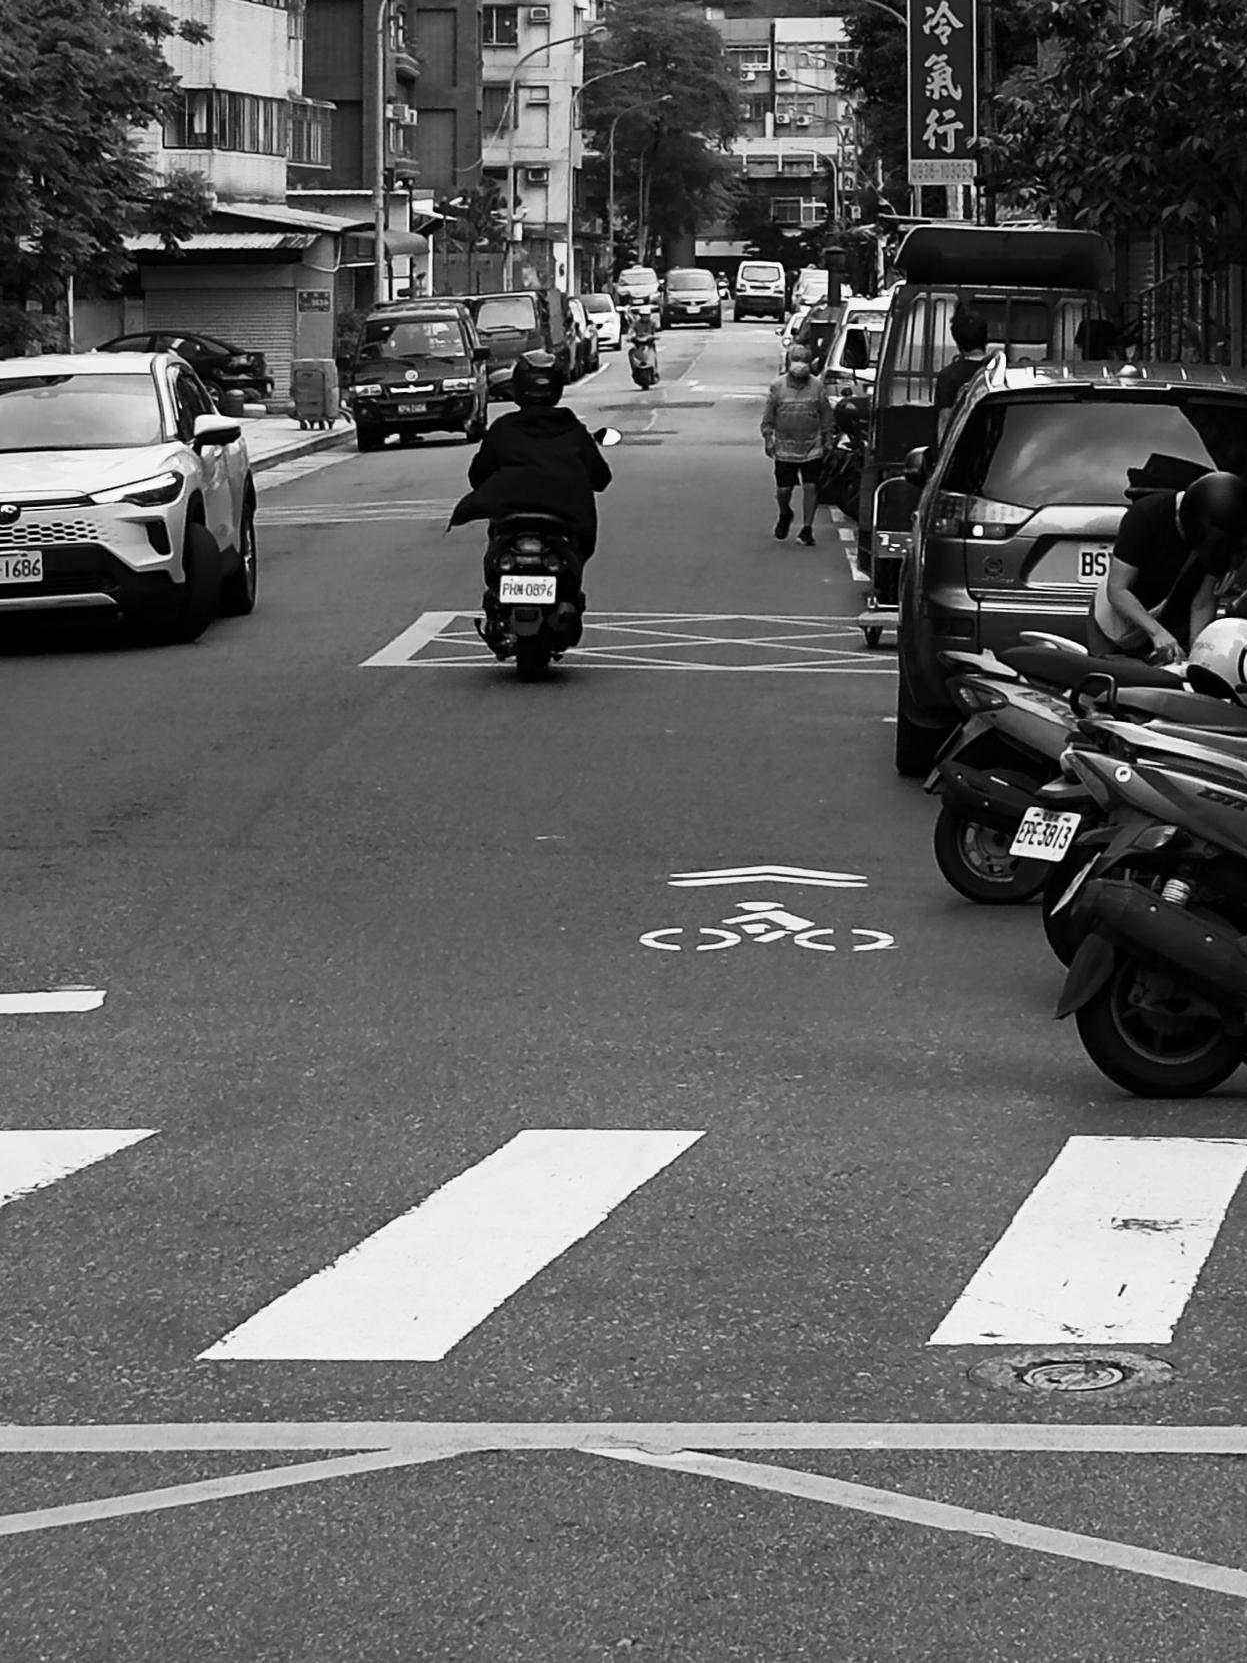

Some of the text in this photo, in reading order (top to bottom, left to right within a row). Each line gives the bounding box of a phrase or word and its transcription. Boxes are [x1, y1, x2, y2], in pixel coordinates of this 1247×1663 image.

[922, 0, 965, 153] 冷氣行
[1081, 551, 1114, 577] BS
